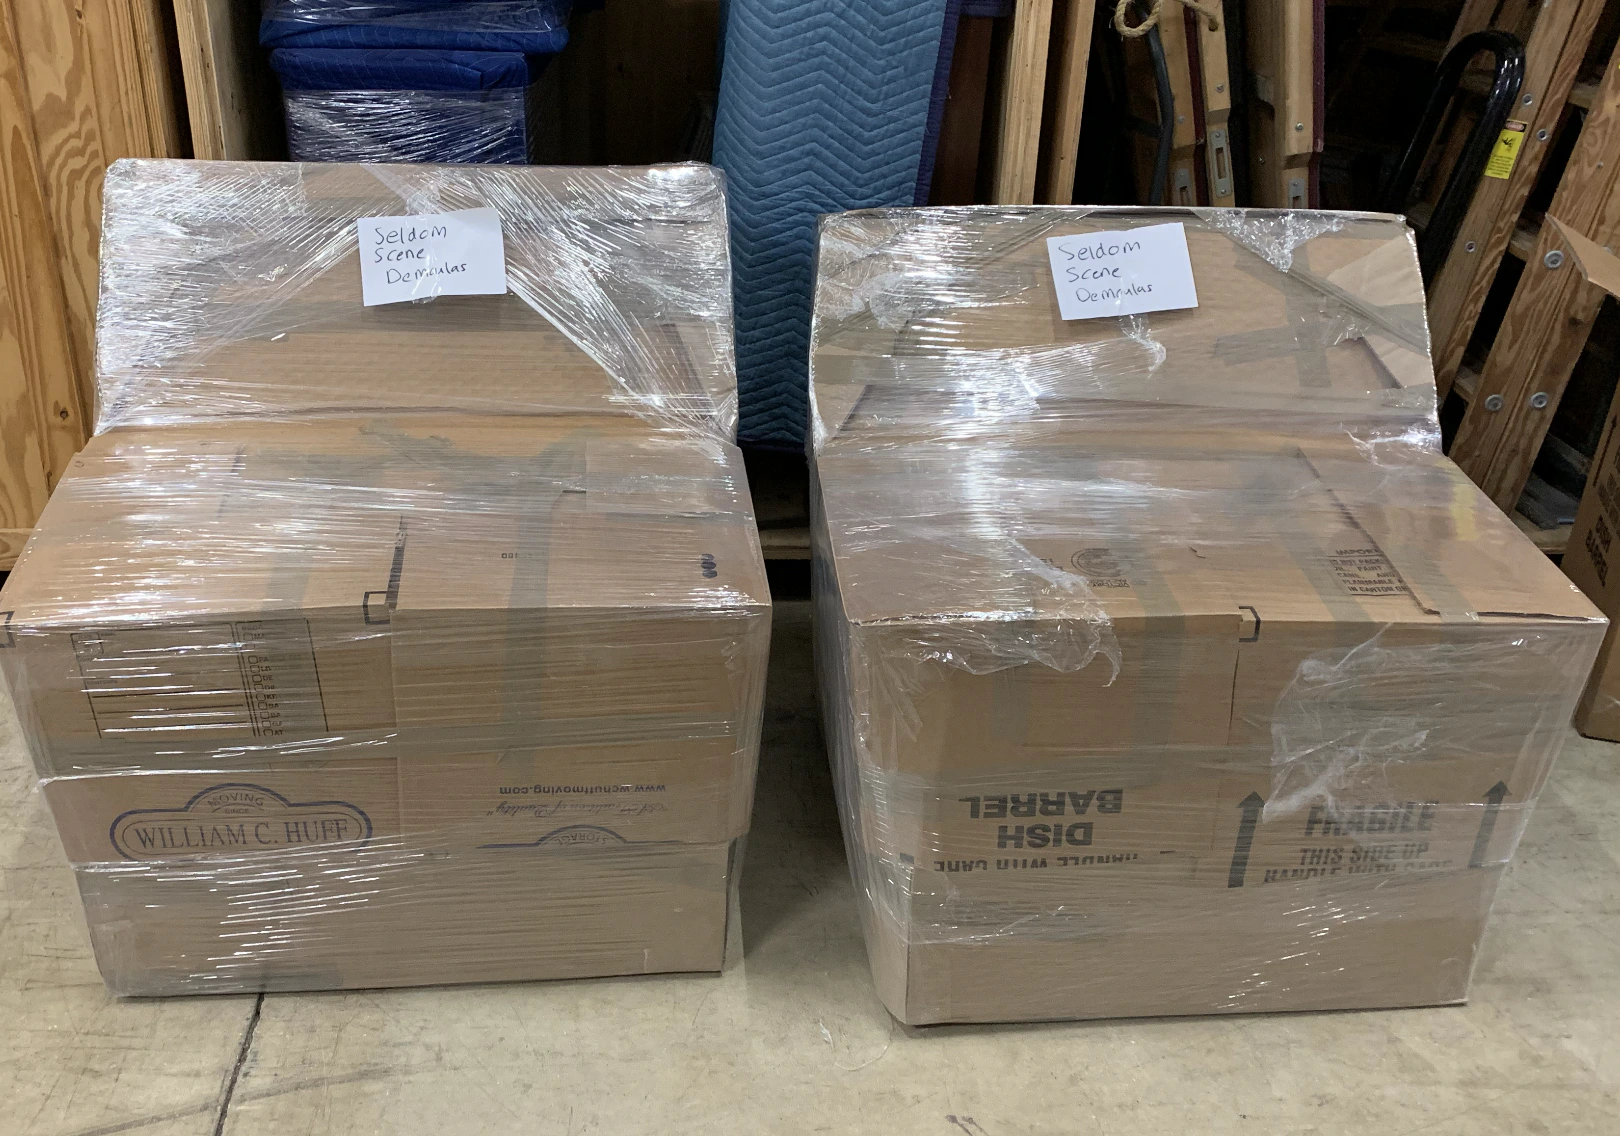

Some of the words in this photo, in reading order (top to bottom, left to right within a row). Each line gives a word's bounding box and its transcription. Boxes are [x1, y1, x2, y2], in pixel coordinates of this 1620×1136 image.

[374, 226, 448, 246] Seldom
[374, 248, 426, 264] Scene
[1058, 241, 1141, 261] Seldom
[1066, 267, 1122, 283] Scene
[207, 792, 265, 808] MOVING
[958, 788, 1124, 819] BARREL
[1305, 800, 1440, 837] FRAGILE
[134, 823, 248, 850] WILLIAM
[254, 822, 278, 845] C.
[284, 818, 350, 844] HUFF
[997, 822, 1094, 848] DISH
[1300, 846, 1344, 866] THIS
[1349, 844, 1398, 864] SIDE
[1402, 842, 1430, 860] UP
